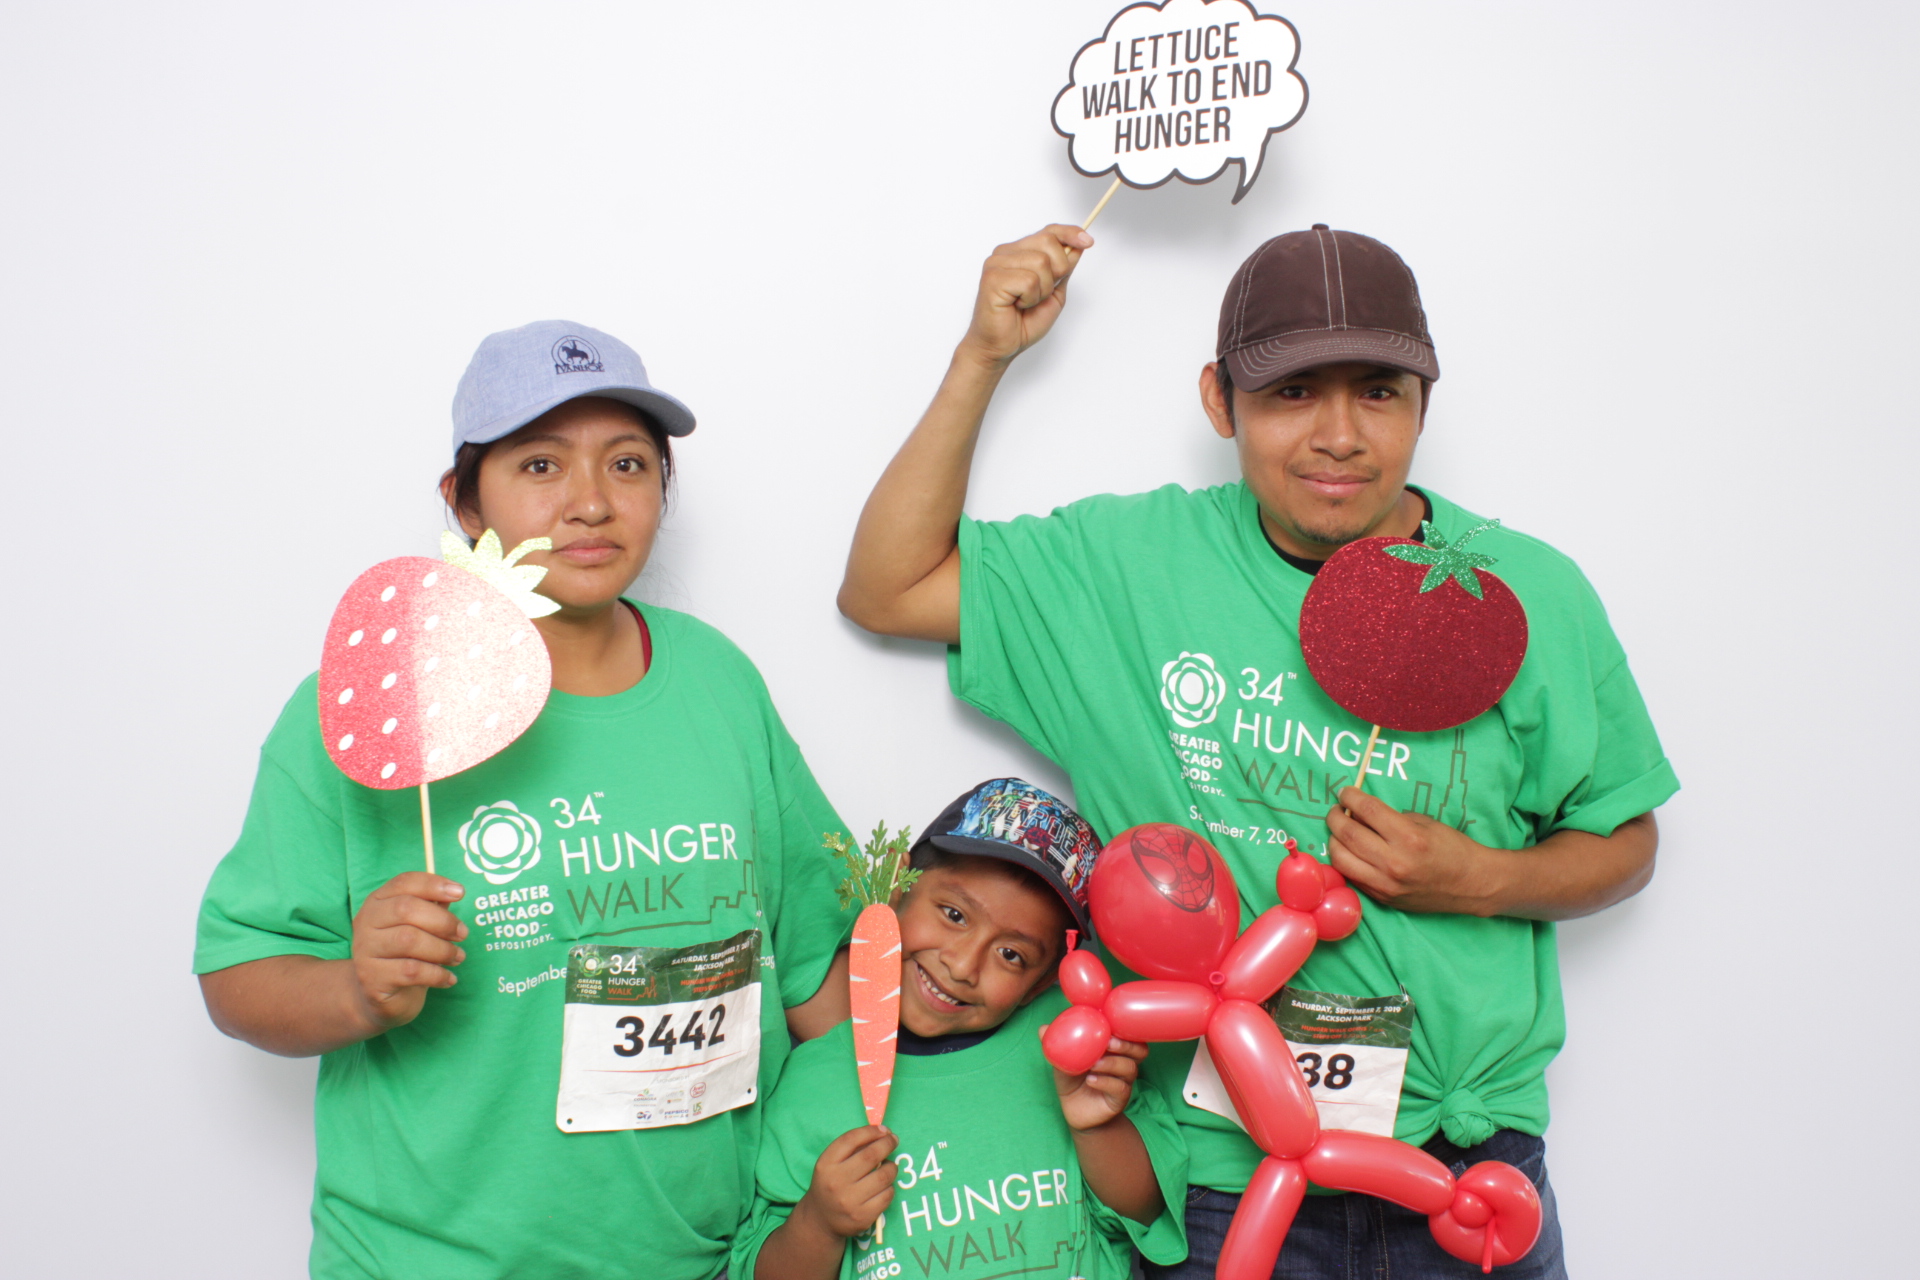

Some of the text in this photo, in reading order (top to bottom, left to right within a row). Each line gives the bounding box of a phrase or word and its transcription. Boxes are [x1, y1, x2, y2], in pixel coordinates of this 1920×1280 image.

[1114, 21, 1240, 75] LETTUCE
[1082, 59, 1272, 120] WALK TO END
[1114, 106, 1231, 154] HUNGER
[1232, 708, 1411, 780] HUNGER
[1233, 753, 1349, 805] WALK
[559, 822, 738, 877] HUNGER
[979, 797, 1094, 877] HEROES
[1248, 826, 1261, 845] 7,
[474, 884, 550, 910] GREATER
[474, 901, 554, 927] CHICAGO
[566, 873, 685, 925] WALK
[497, 964, 569, 997] Septembe
[607, 977, 646, 986] HUNGER
[607, 987, 633, 996] WALK
[613, 1003, 727, 1058] 3442
[1291, 1000, 1333, 1014] SATURDAY,
[1335, 1006, 1375, 1014] SEPTEMBER
[1384, 1006, 1402, 1014] 2019
[1316, 1014, 1352, 1022] JACKSON
[901, 1168, 1069, 1237] HUNGER
[909, 1220, 1028, 1279] WALK
